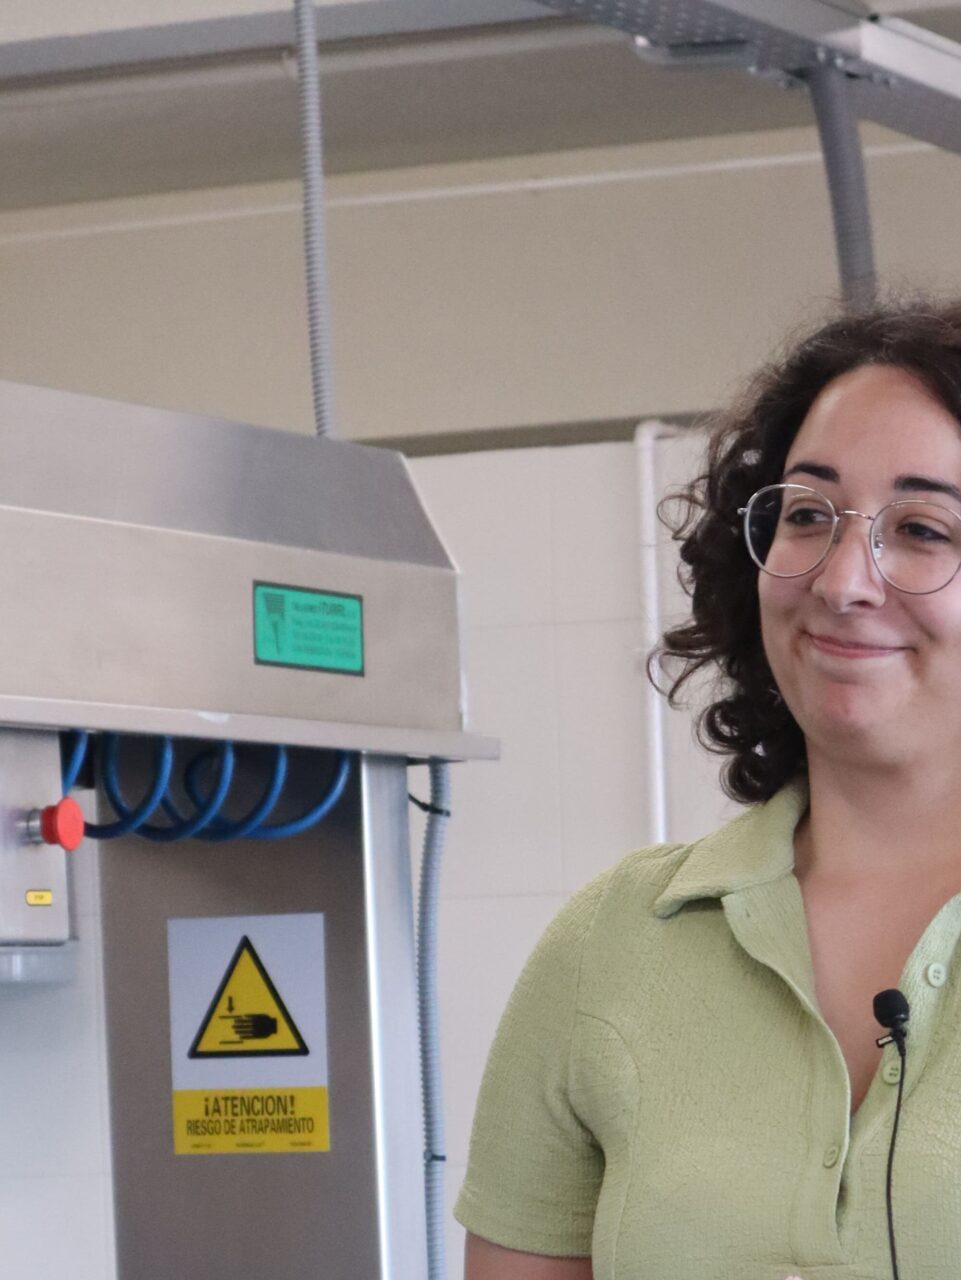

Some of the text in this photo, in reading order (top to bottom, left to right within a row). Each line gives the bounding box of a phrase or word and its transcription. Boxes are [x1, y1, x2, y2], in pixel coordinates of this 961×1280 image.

[204, 1094, 295, 1117] ¡ATENCION!
[187, 1117, 314, 1136] RIESGO DE ATRAPAMIENTO
